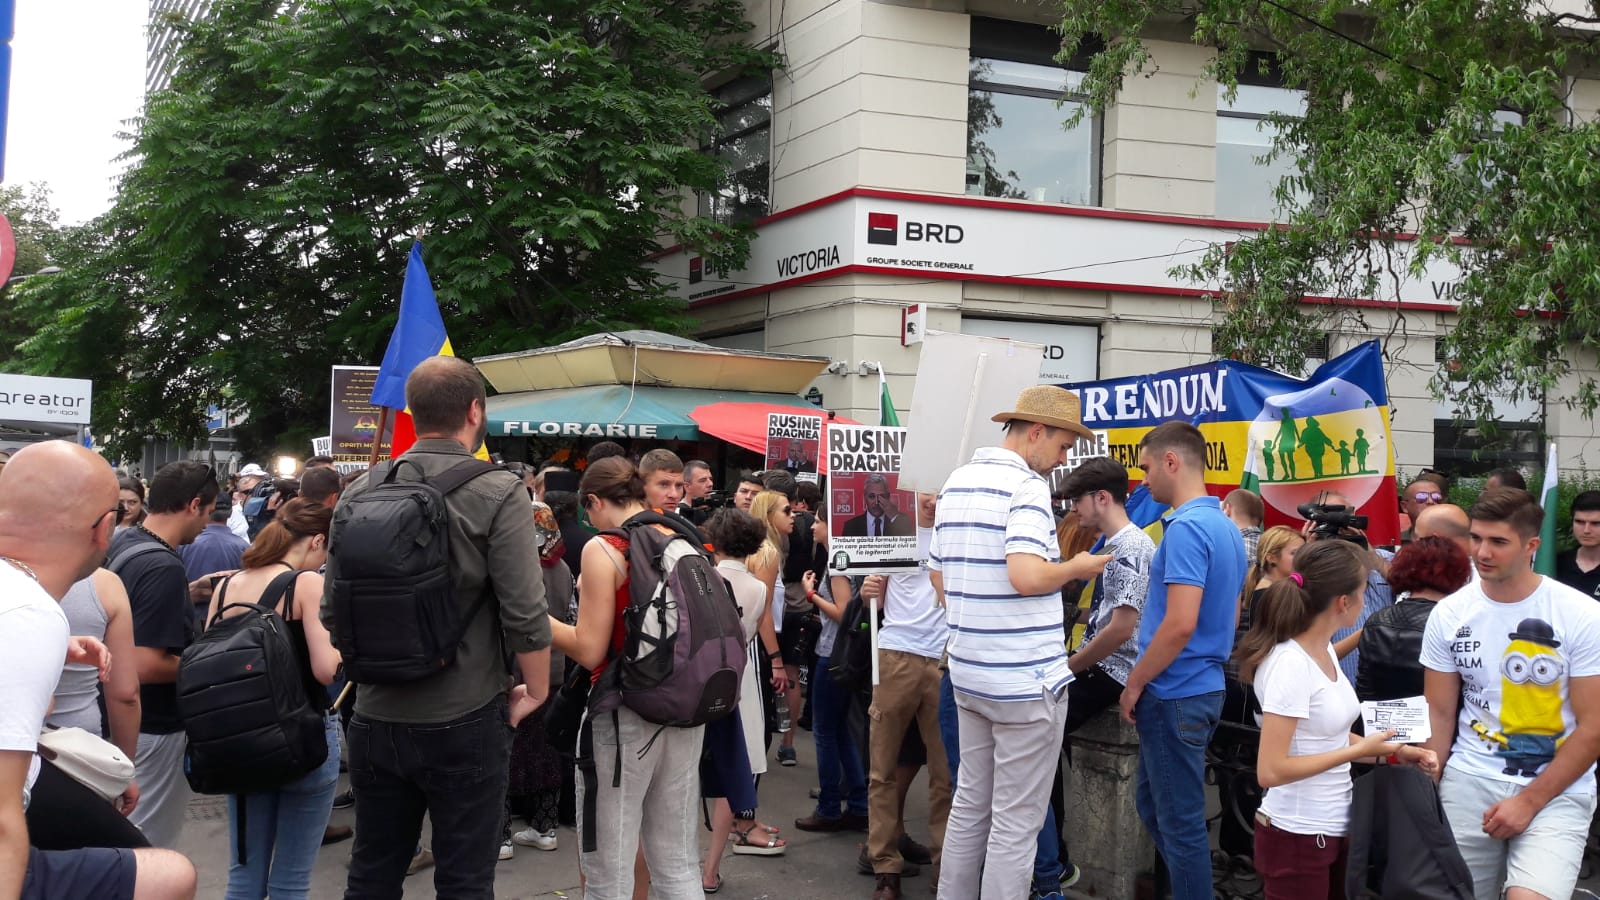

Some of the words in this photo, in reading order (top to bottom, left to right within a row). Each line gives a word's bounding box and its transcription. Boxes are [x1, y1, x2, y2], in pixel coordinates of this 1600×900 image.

[905, 221, 964, 244] BRD
[777, 245, 840, 278] VICTORIA
[866, 257, 899, 265] GROUPE
[901, 259, 933, 268] SOCIETE
[934, 261, 974, 270] GENERALE
[503, 421, 657, 438] FLORARIE
[769, 414, 821, 430] RUSINE
[768, 427, 819, 440] DRAGNEA
